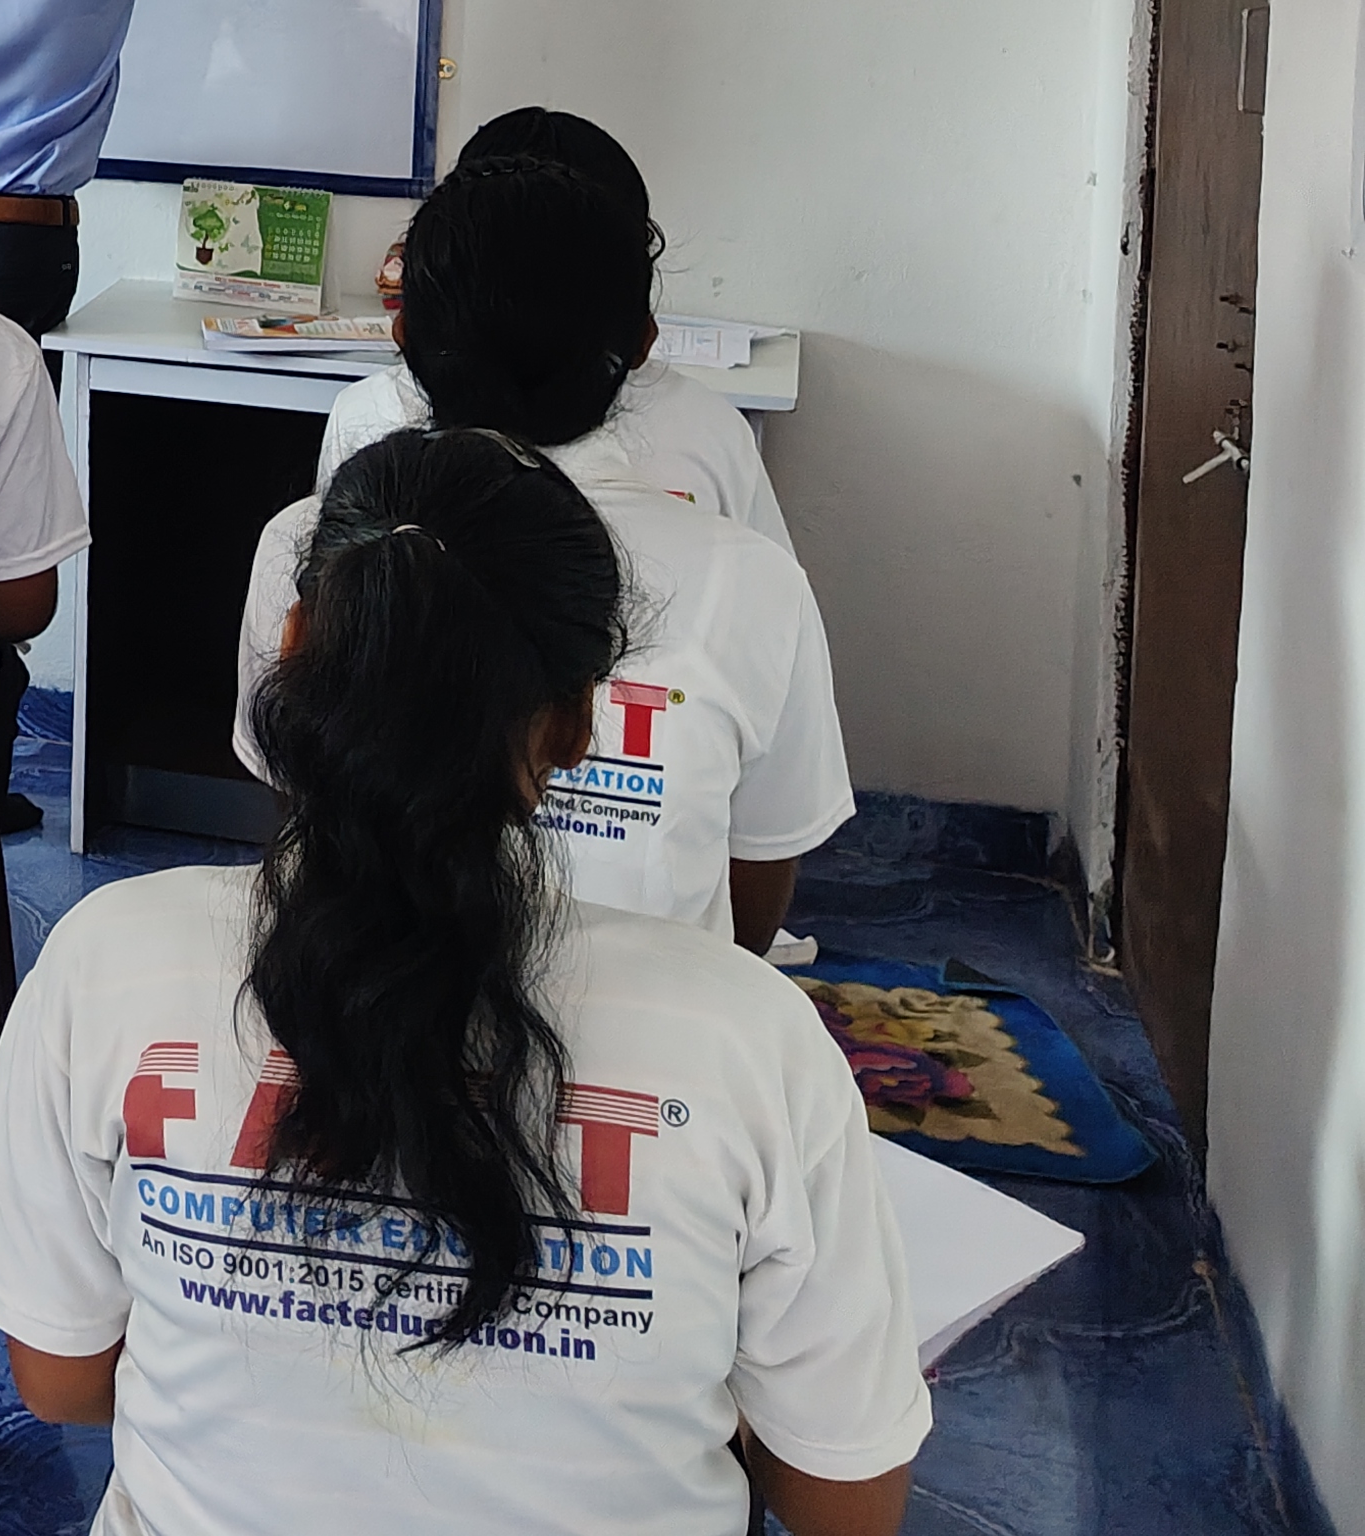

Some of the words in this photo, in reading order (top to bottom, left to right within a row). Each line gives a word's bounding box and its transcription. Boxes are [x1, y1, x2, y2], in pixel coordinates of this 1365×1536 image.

[580, 799, 661, 827] Company
[137, 1178, 365, 1245] COMPUTER
[141, 1228, 166, 1258] An
[171, 1239, 215, 1270] ISO
[222, 1252, 365, 1293] 9001:2015
[373, 1272, 463, 1307] Certifi
[511, 1292, 654, 1335] Company
